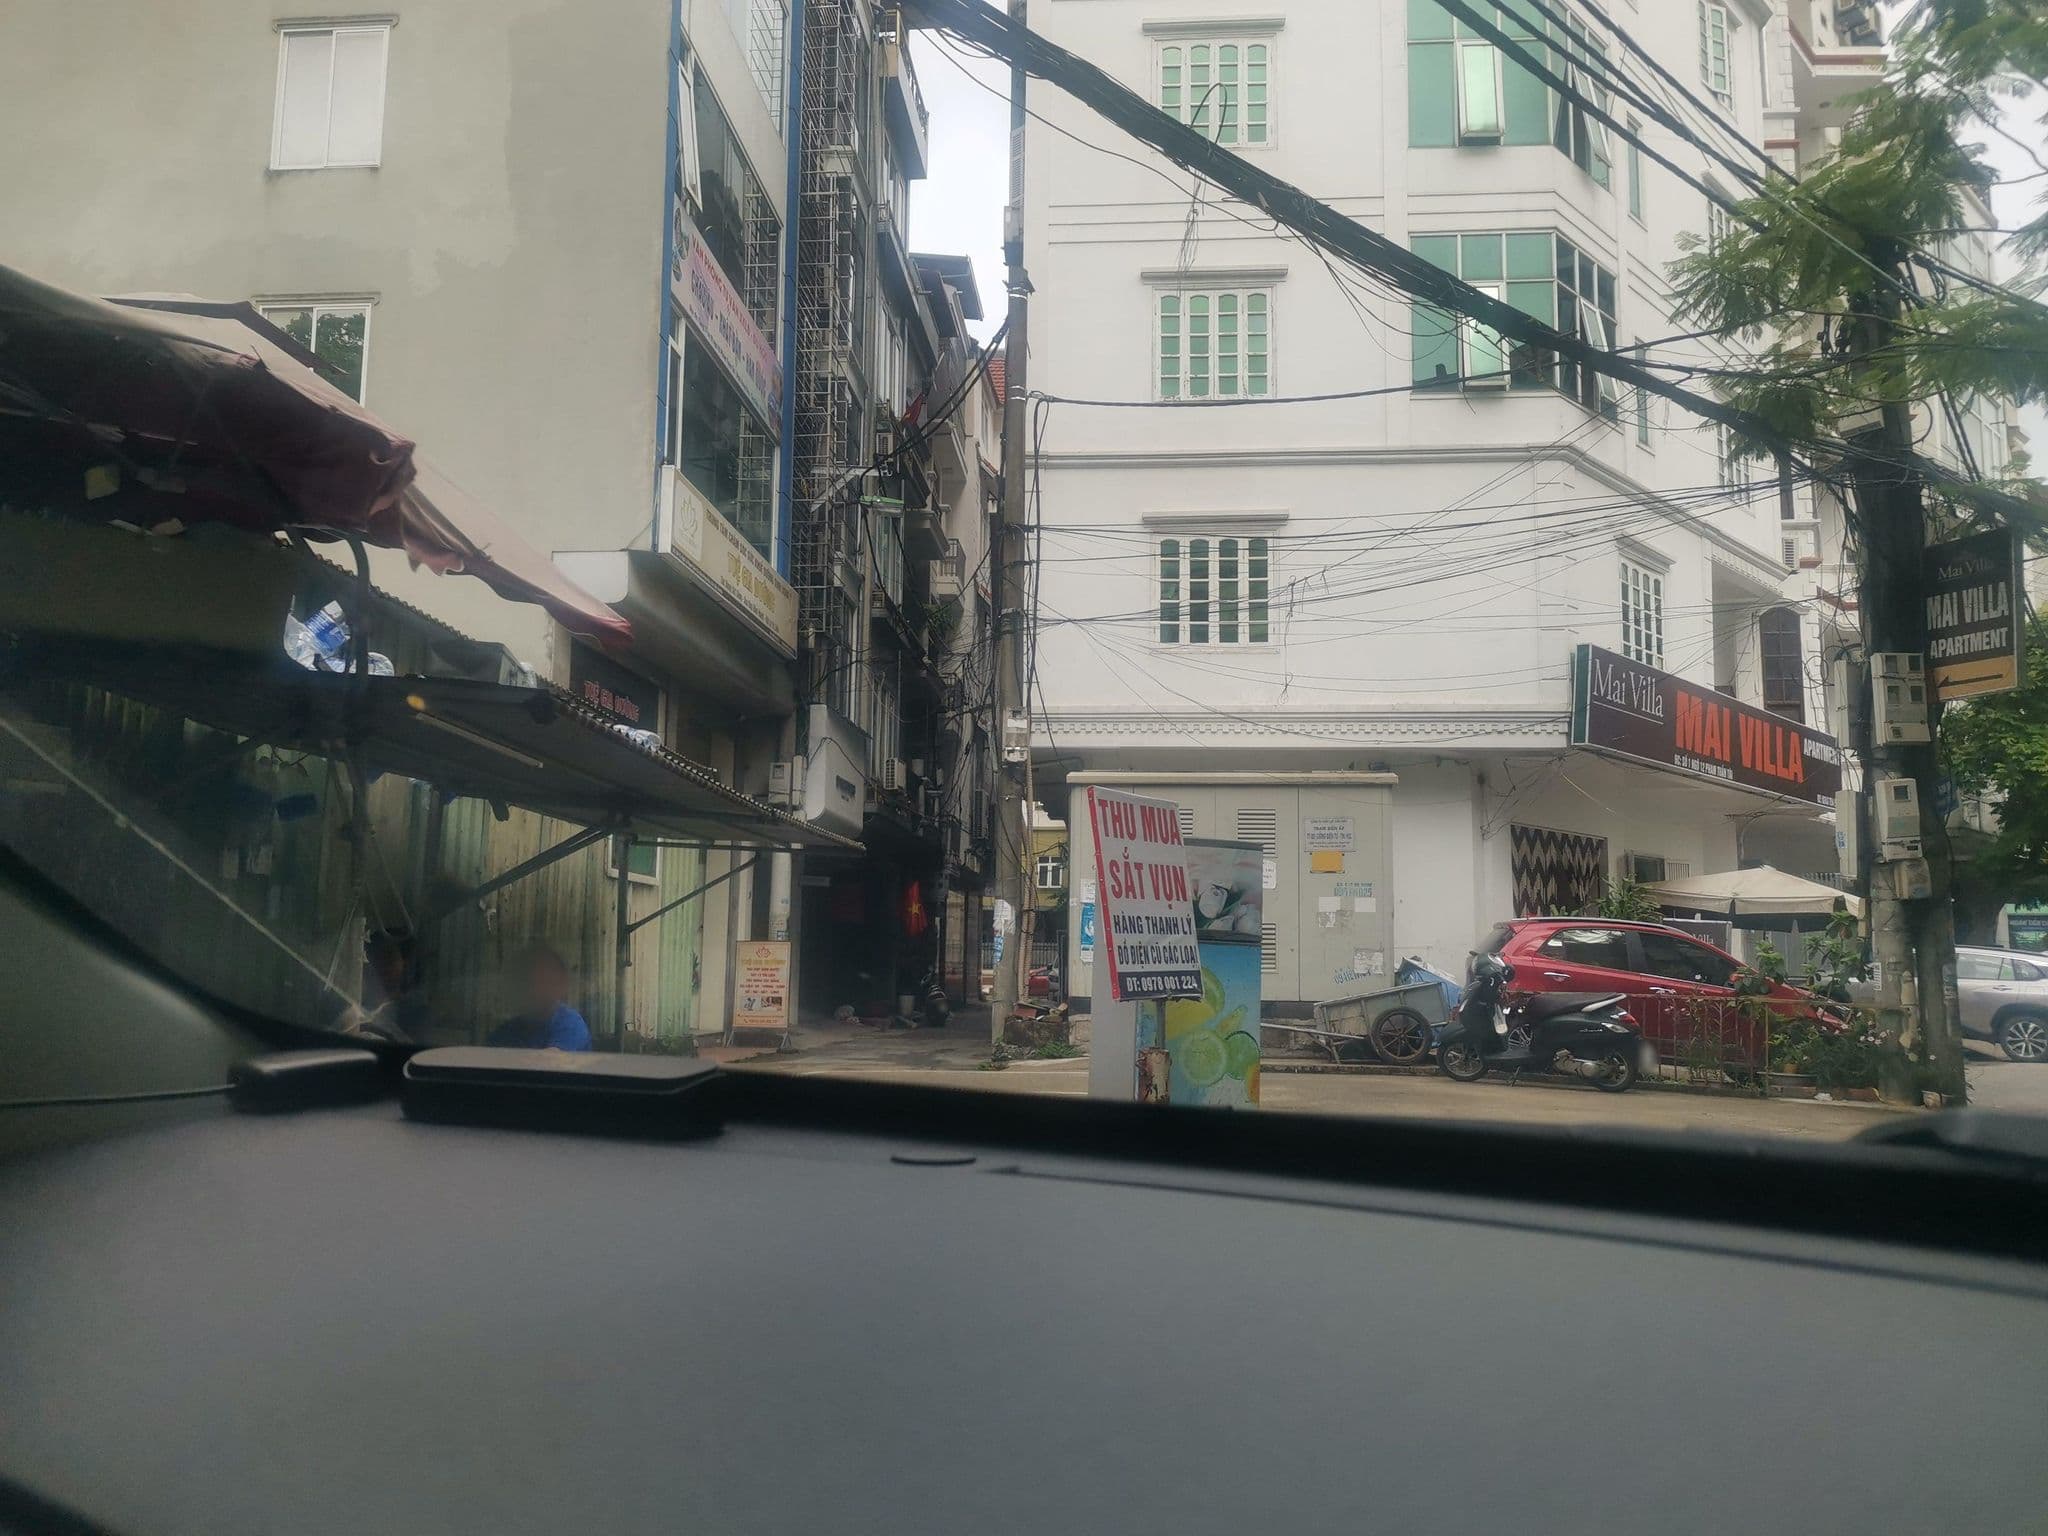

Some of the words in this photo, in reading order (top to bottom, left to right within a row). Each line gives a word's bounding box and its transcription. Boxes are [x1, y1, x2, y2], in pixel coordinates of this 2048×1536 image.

[1938, 565, 1962, 581] Mai
[1926, 590, 1960, 631] MAI
[1962, 581, 2010, 624] VILLA
[1930, 626, 2009, 660] APARTMENT
[1592, 658, 1627, 707] Mai
[1627, 670, 1665, 719] Villa
[1674, 689, 1732, 763] MAI
[1738, 712, 1806, 785] VILLA
[1802, 737, 1841, 768] APARTMENT
[1097, 798, 1137, 841] THU
[1140, 804, 1182, 847] MUA
[1108, 846, 1145, 901] SẮT
[1148, 862, 1189, 910] VỤN
[1113, 911, 1144, 935] HÀNG
[1144, 914, 1180, 936] THANH
[1180, 912, 1193, 936] LÝ
[1117, 943, 1130, 966] ĐỒ
[1130, 944, 1149, 969] ĐIỆN
[1149, 943, 1162, 966] CŨ
[1162, 943, 1179, 966] CÁC
[1179, 943, 1199, 970] LOẠI
[1140, 975, 1164, 992] 0978
[1164, 975, 1180, 991] 001
[1181, 974, 1198, 990] 224
